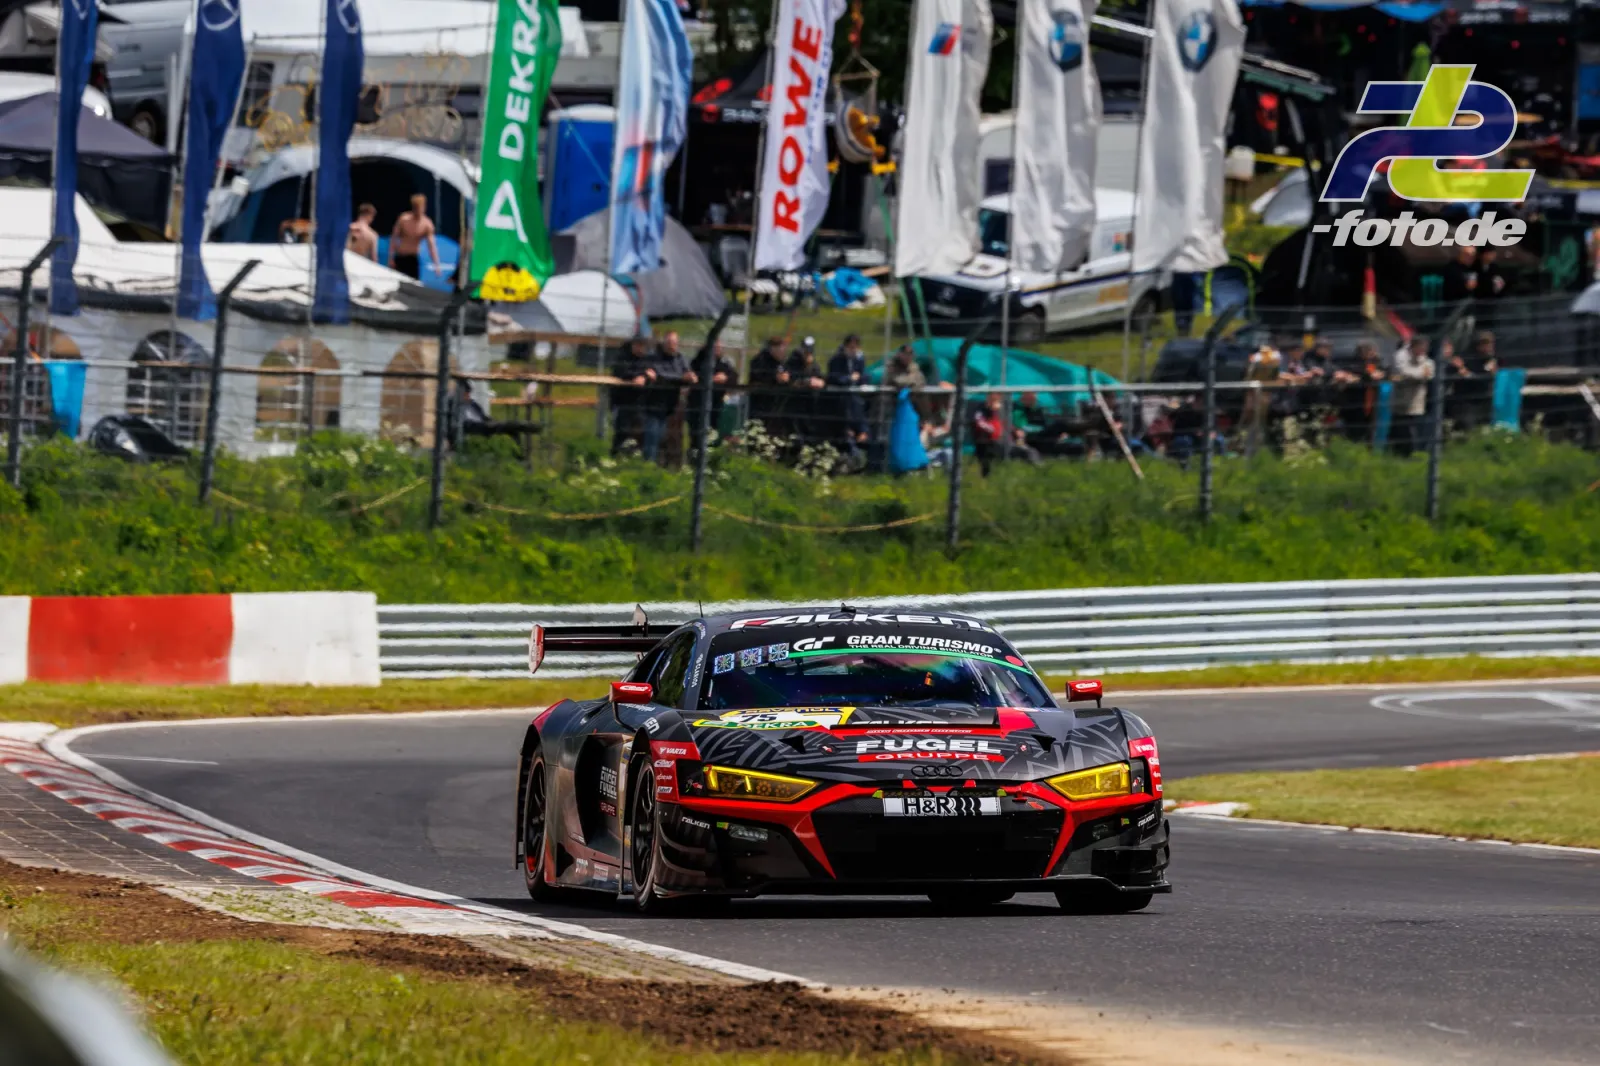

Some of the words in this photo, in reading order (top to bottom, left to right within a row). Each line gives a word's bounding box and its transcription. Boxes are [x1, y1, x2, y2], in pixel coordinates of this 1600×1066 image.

[773, 17, 823, 233] ROWE
[730, 614, 982, 629] FALKEN
[847, 635, 902, 646] GRAN
[740, 714, 777, 723] 75
[667, 747, 687, 755] VARTA
[856, 739, 1001, 754] FUGEL
[875, 752, 990, 761] GRUPPE
[681, 816, 710, 830] FALKEN
